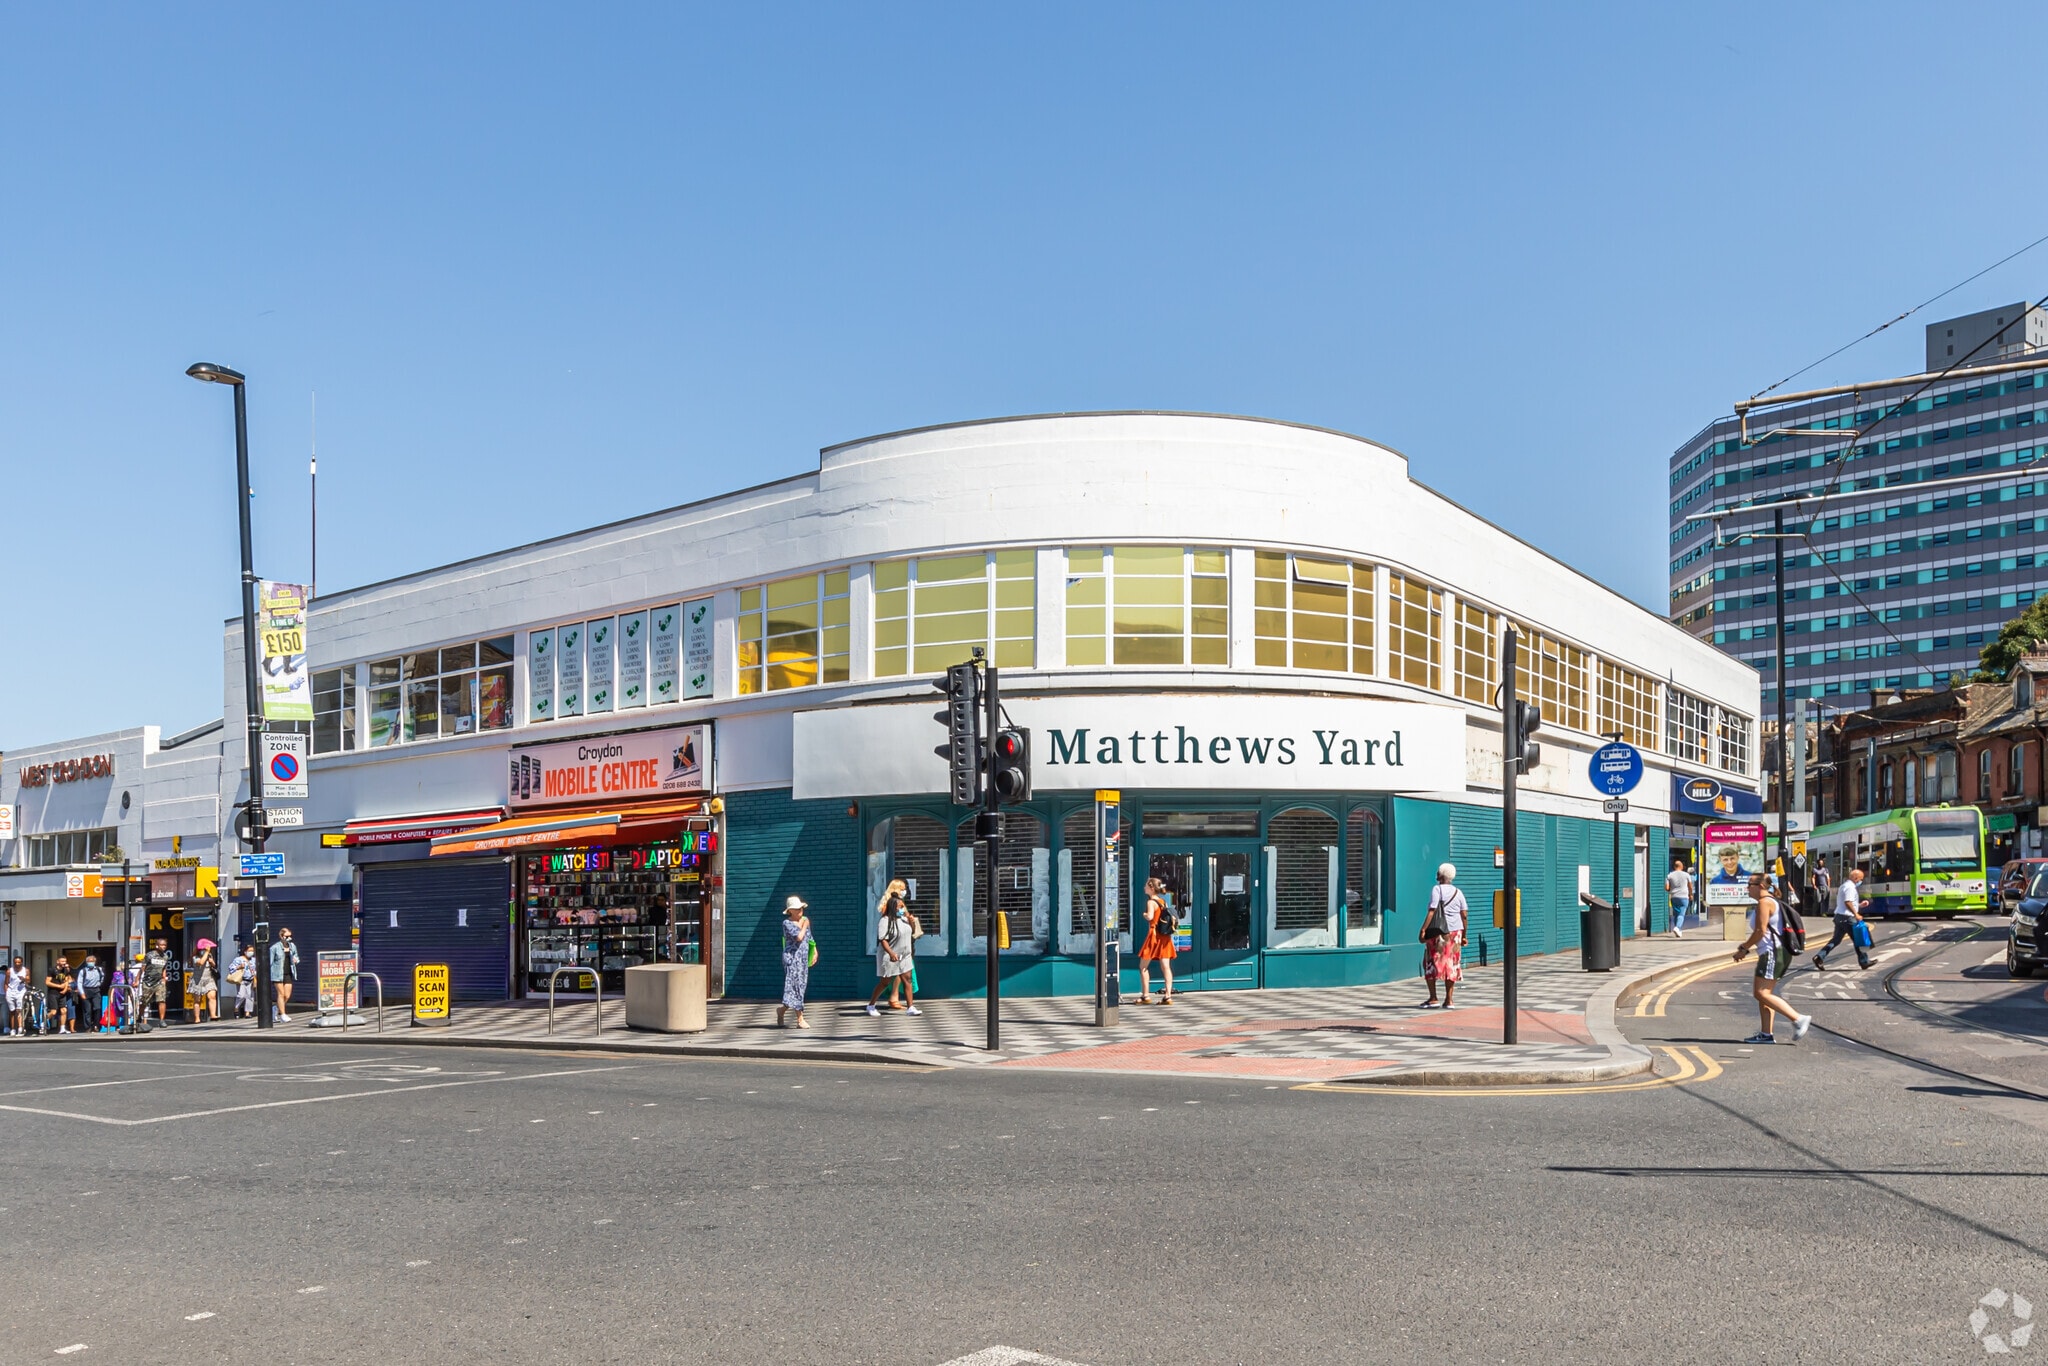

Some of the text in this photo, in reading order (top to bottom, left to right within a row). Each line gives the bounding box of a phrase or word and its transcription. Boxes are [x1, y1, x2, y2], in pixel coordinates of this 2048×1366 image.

[266, 631, 301, 653] £150
[270, 743, 297, 751] ZONE
[1046, 726, 1404, 767] Matthews Yard
[578, 743, 623, 762] Croydon
[20, 753, 115, 788] WEST CROYDON
[545, 758, 658, 798] MOBILE CENTRE
[1692, 788, 1712, 797] HILL
[268, 808, 302, 816] STATION
[398, 830, 426, 838] COMPUTERS
[474, 831, 560, 849] CROYDON MOBILE CENTRE
[551, 854, 590, 870] WATCH
[322, 967, 354, 976] MOBILES
[418, 970, 445, 978] PRINT
[419, 983, 445, 992] SCAN
[419, 997, 444, 1006] COPY
